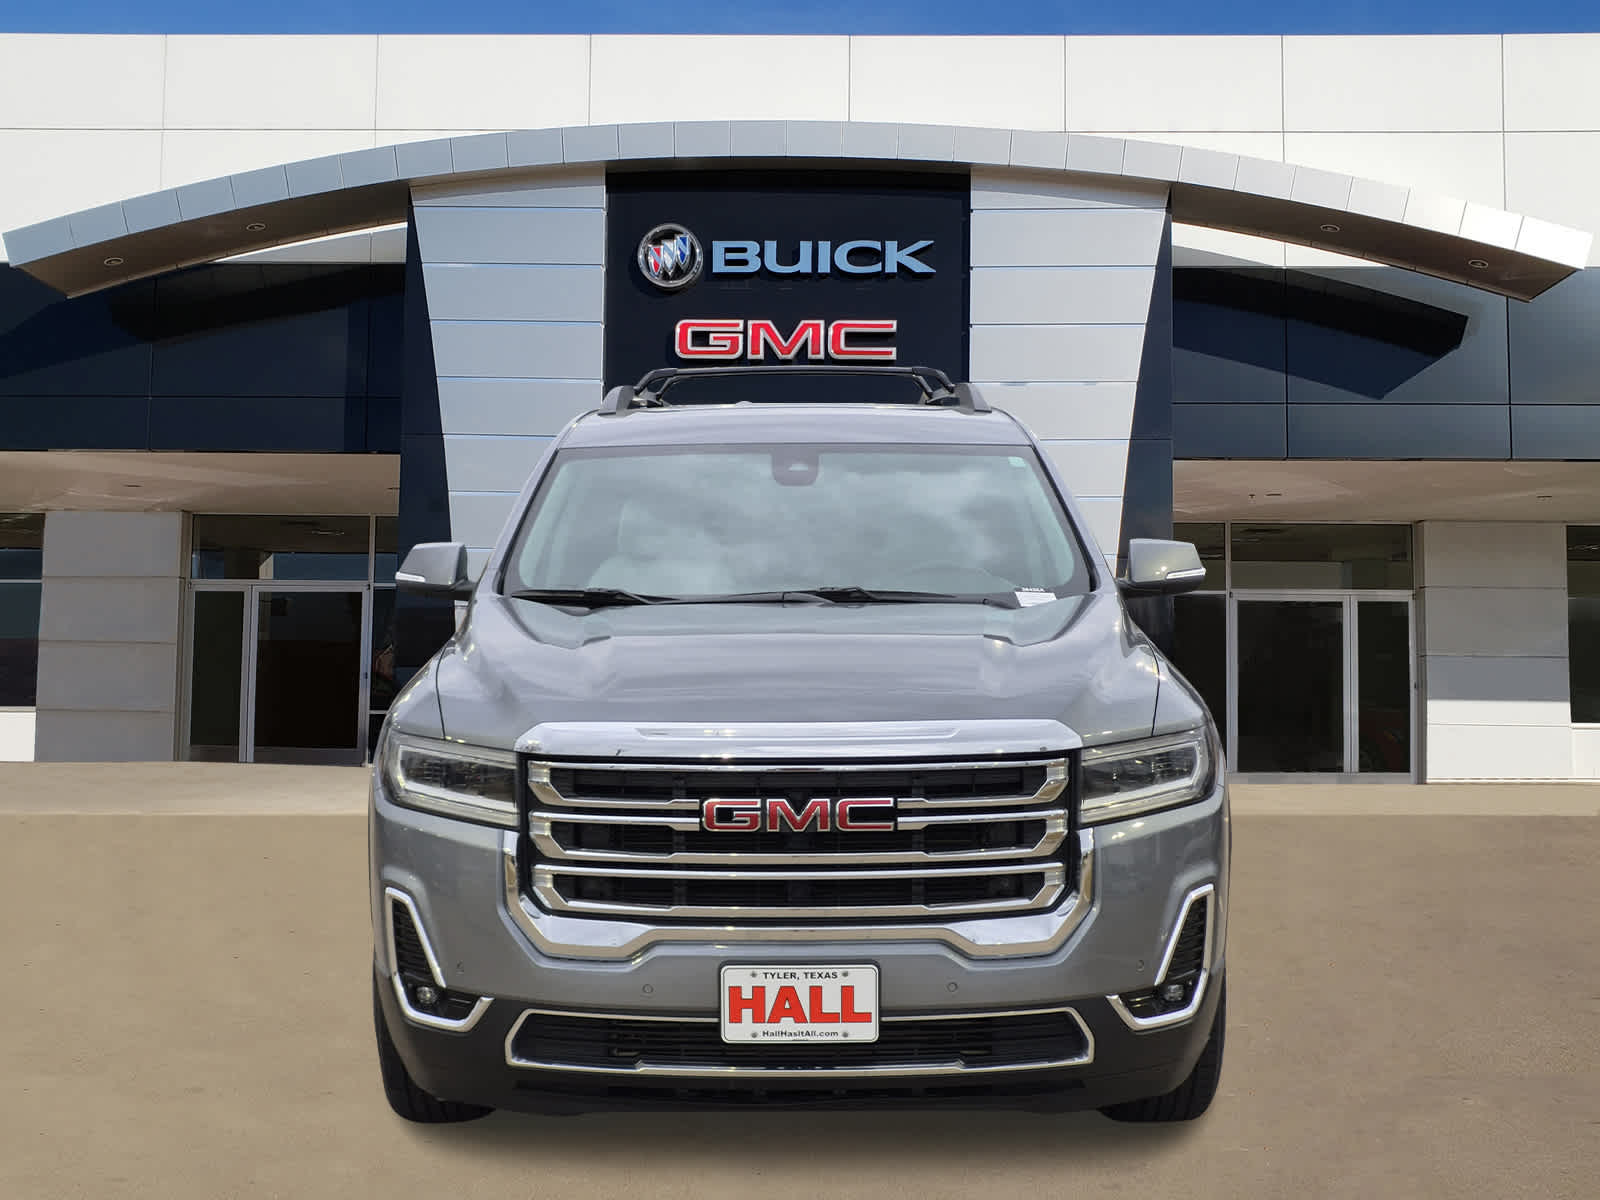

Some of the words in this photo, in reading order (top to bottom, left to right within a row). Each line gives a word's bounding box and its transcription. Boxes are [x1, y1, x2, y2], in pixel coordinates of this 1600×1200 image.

[712, 240, 936, 273] BUICK
[675, 319, 897, 360] GMC
[702, 797, 894, 832] GMC
[763, 971, 800, 980] TYLER,
[803, 971, 838, 979] TEXAS
[728, 985, 872, 1024] HALL
[762, 1030, 839, 1038] HallHasItAll.com
